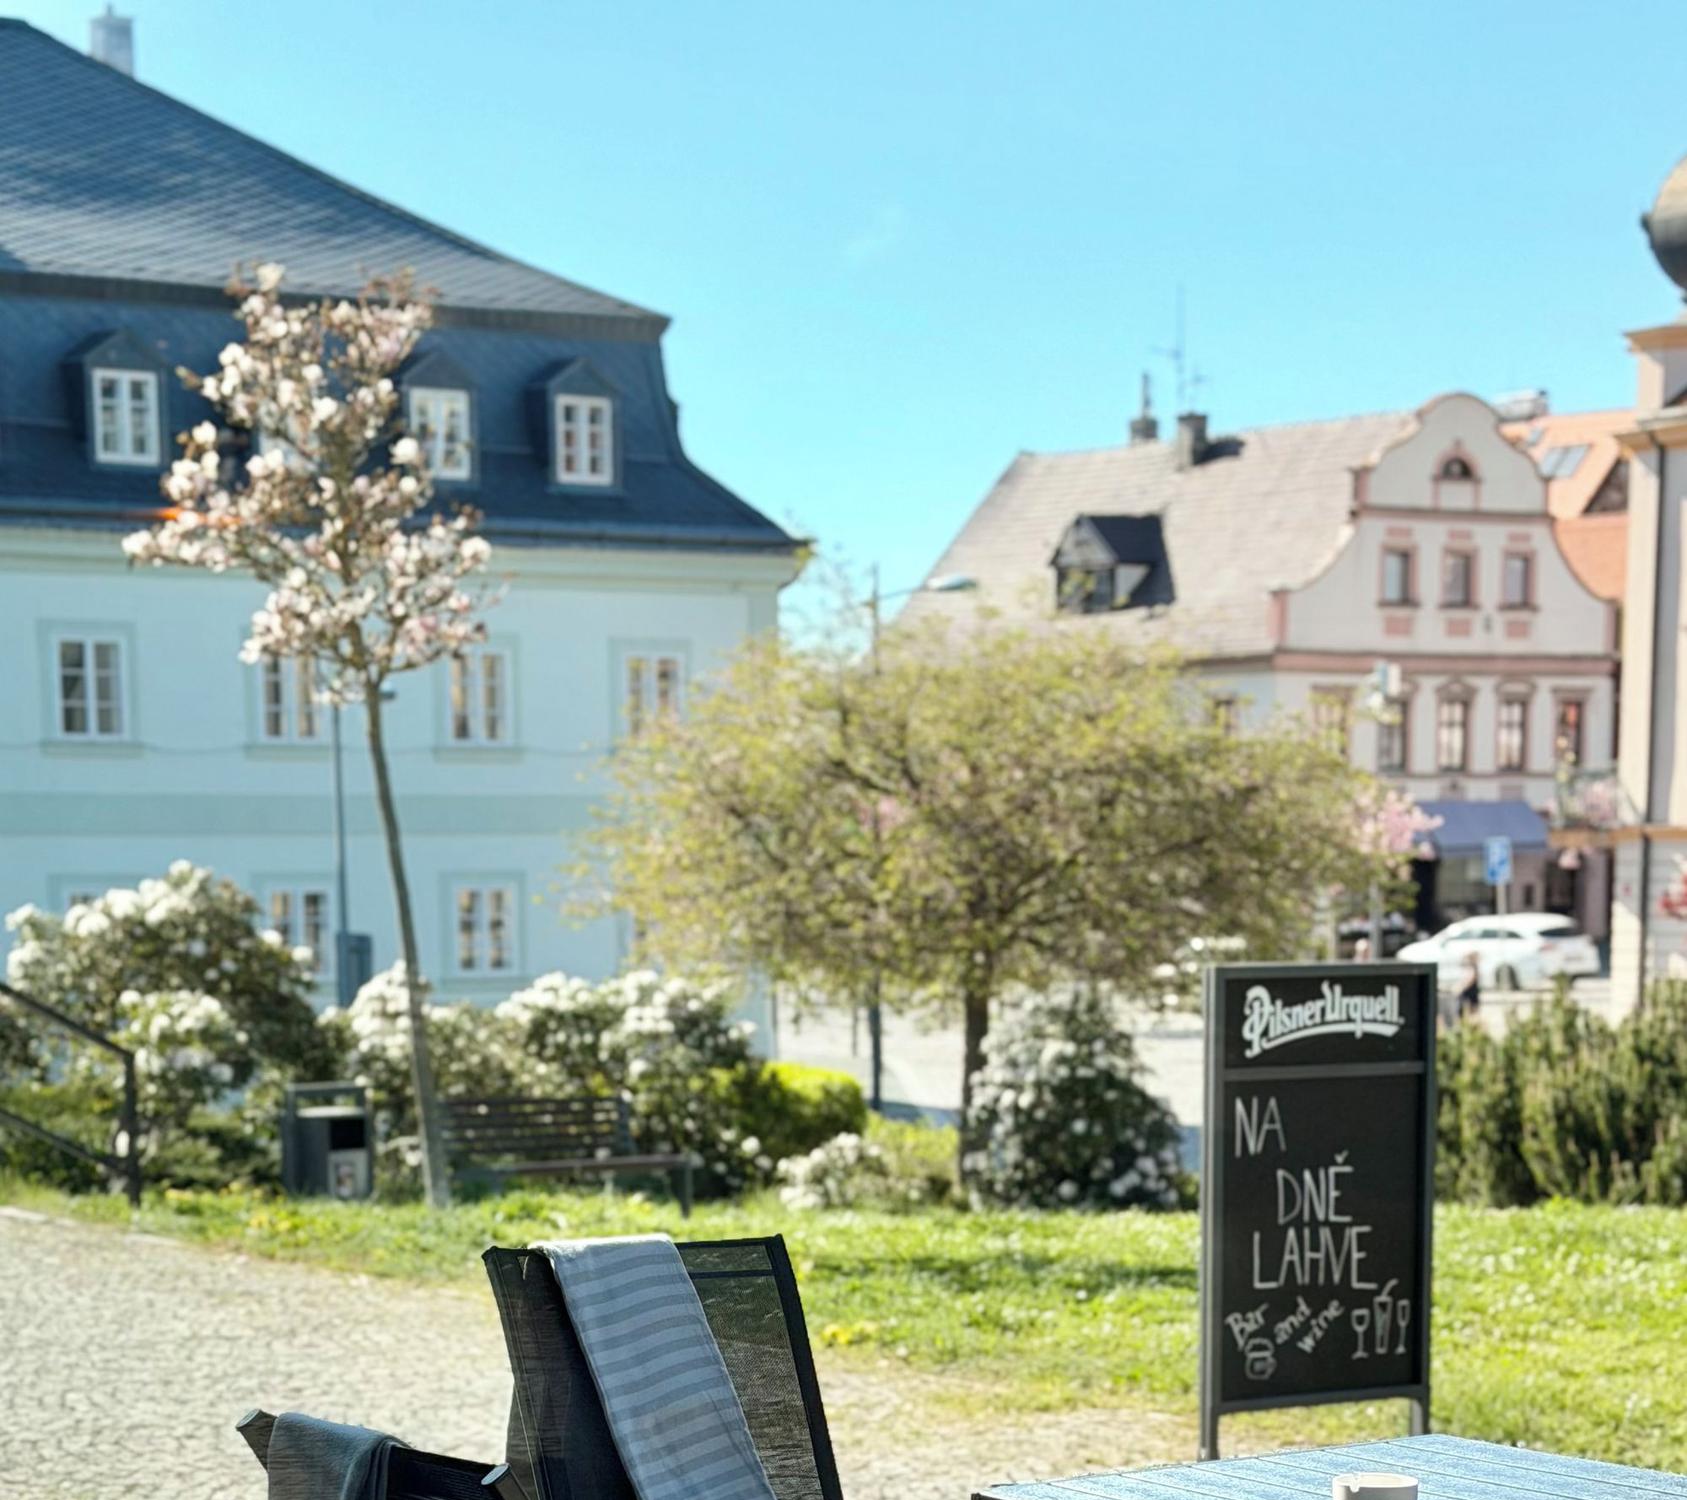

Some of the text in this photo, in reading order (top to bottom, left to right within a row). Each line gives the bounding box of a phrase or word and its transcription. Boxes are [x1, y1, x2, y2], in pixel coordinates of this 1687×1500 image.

[1242, 980, 1400, 1058] Pilsner Urquell
[1234, 1096, 1287, 1158] NA
[1276, 1150, 1354, 1225] DNĚ
[1253, 1225, 1378, 1290] LAHVE
[1224, 1295, 1346, 1354] Bar and wine
